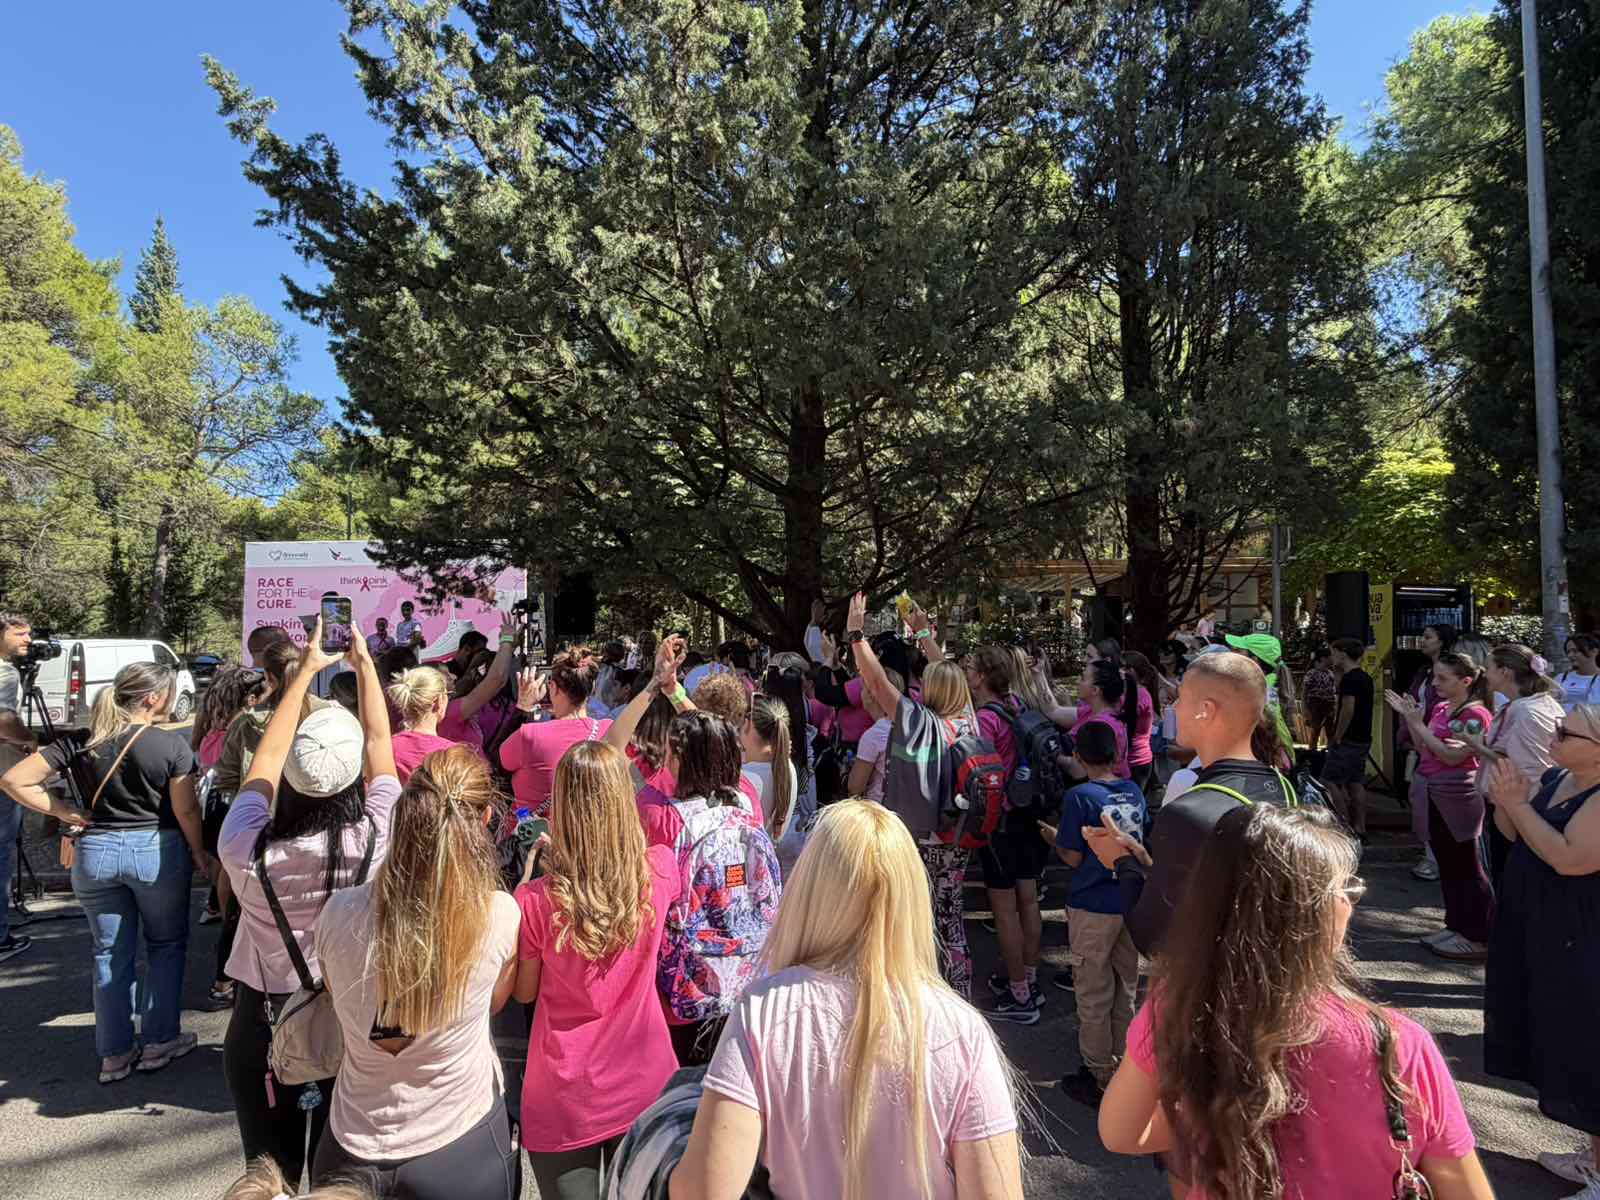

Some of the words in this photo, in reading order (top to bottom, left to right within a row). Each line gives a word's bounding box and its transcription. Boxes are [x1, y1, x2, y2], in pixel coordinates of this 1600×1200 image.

[257, 577, 294, 588] RACE
[340, 576, 362, 584] think
[257, 588, 282, 599] FOR
[285, 588, 308, 598] THE
[256, 599, 297, 609] CURE.
